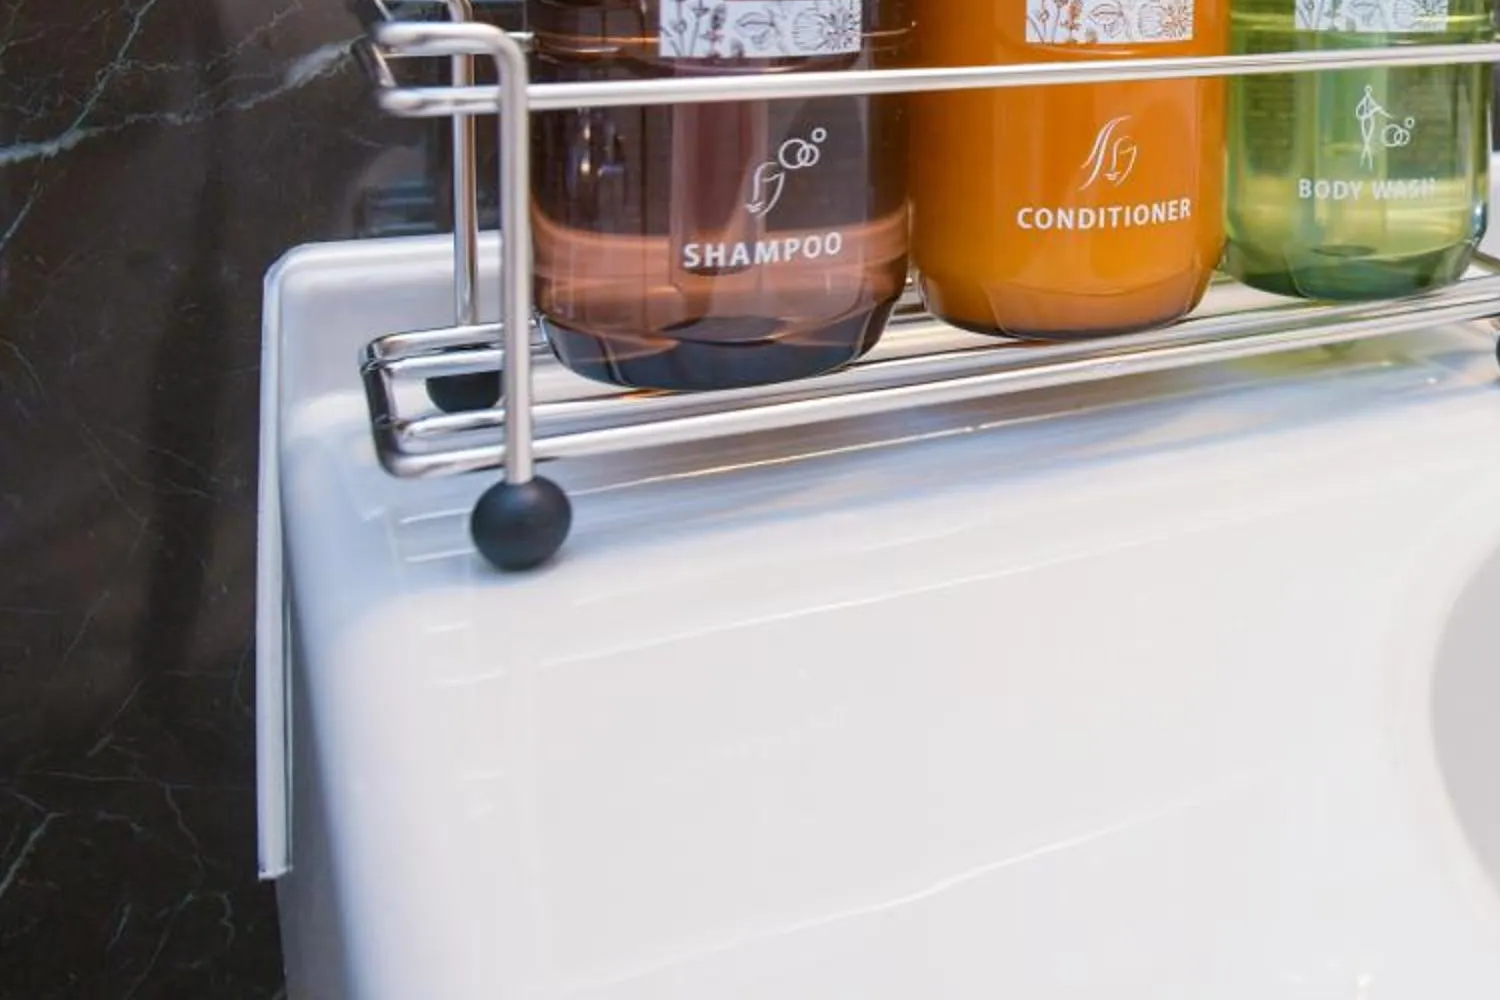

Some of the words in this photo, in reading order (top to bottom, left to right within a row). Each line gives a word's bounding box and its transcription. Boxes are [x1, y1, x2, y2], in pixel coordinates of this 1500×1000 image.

[1298, 177, 1363, 201] BODY
[1370, 176, 1437, 201] WASH
[1017, 197, 1192, 230] CONDITIONER
[682, 231, 843, 269] SHAMPOO
